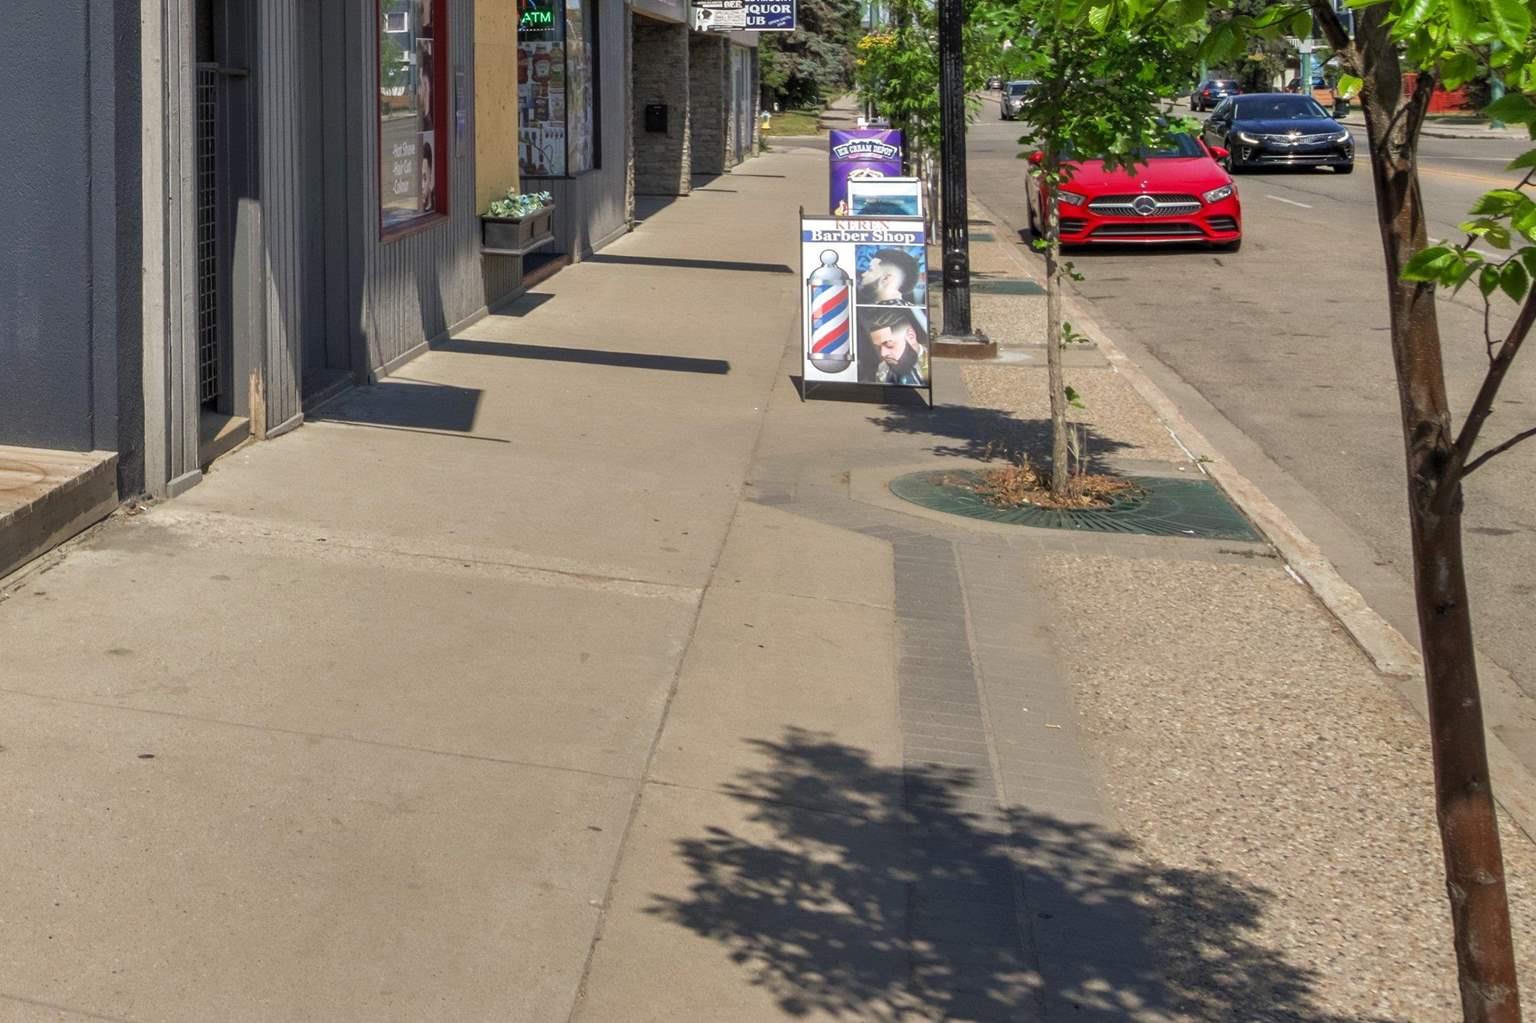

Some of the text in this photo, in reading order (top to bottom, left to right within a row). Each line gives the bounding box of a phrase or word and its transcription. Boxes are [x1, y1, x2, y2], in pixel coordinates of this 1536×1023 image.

[522, 11, 551, 23] ATM
[812, 230, 915, 244] Barber Shop
